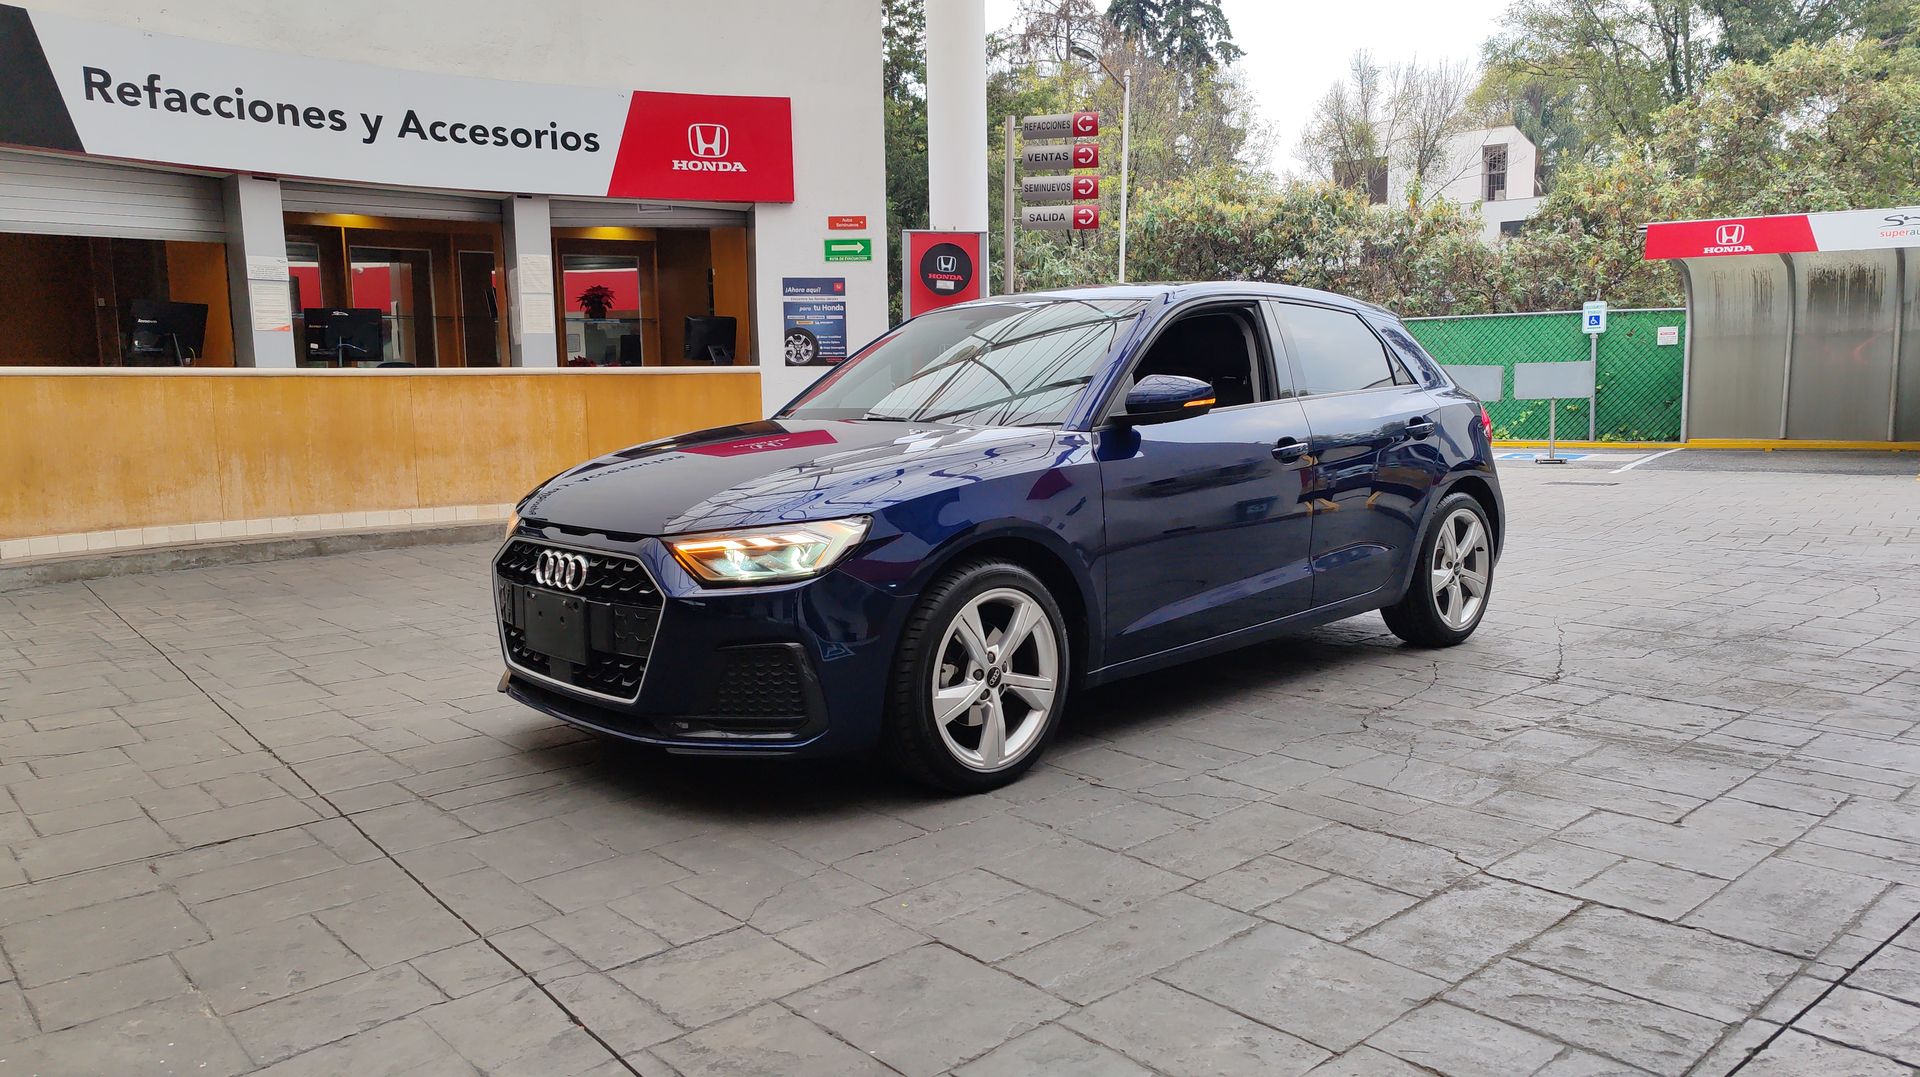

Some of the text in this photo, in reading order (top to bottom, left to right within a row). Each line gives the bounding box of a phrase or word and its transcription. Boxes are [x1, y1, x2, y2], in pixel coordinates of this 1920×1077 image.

[83, 66, 600, 153] Refacciones y Accesorios
[1024, 120, 1071, 131] REFACCIONES
[1028, 152, 1069, 162] VENTAS
[671, 159, 747, 173] HONDA
[1024, 182, 1071, 193] SEMINUEVOS
[1029, 213, 1066, 222] SALIDA
[1703, 245, 1755, 254] HONDA
[928, 273, 964, 281] HONDA
[822, 303, 844, 311] Honda
